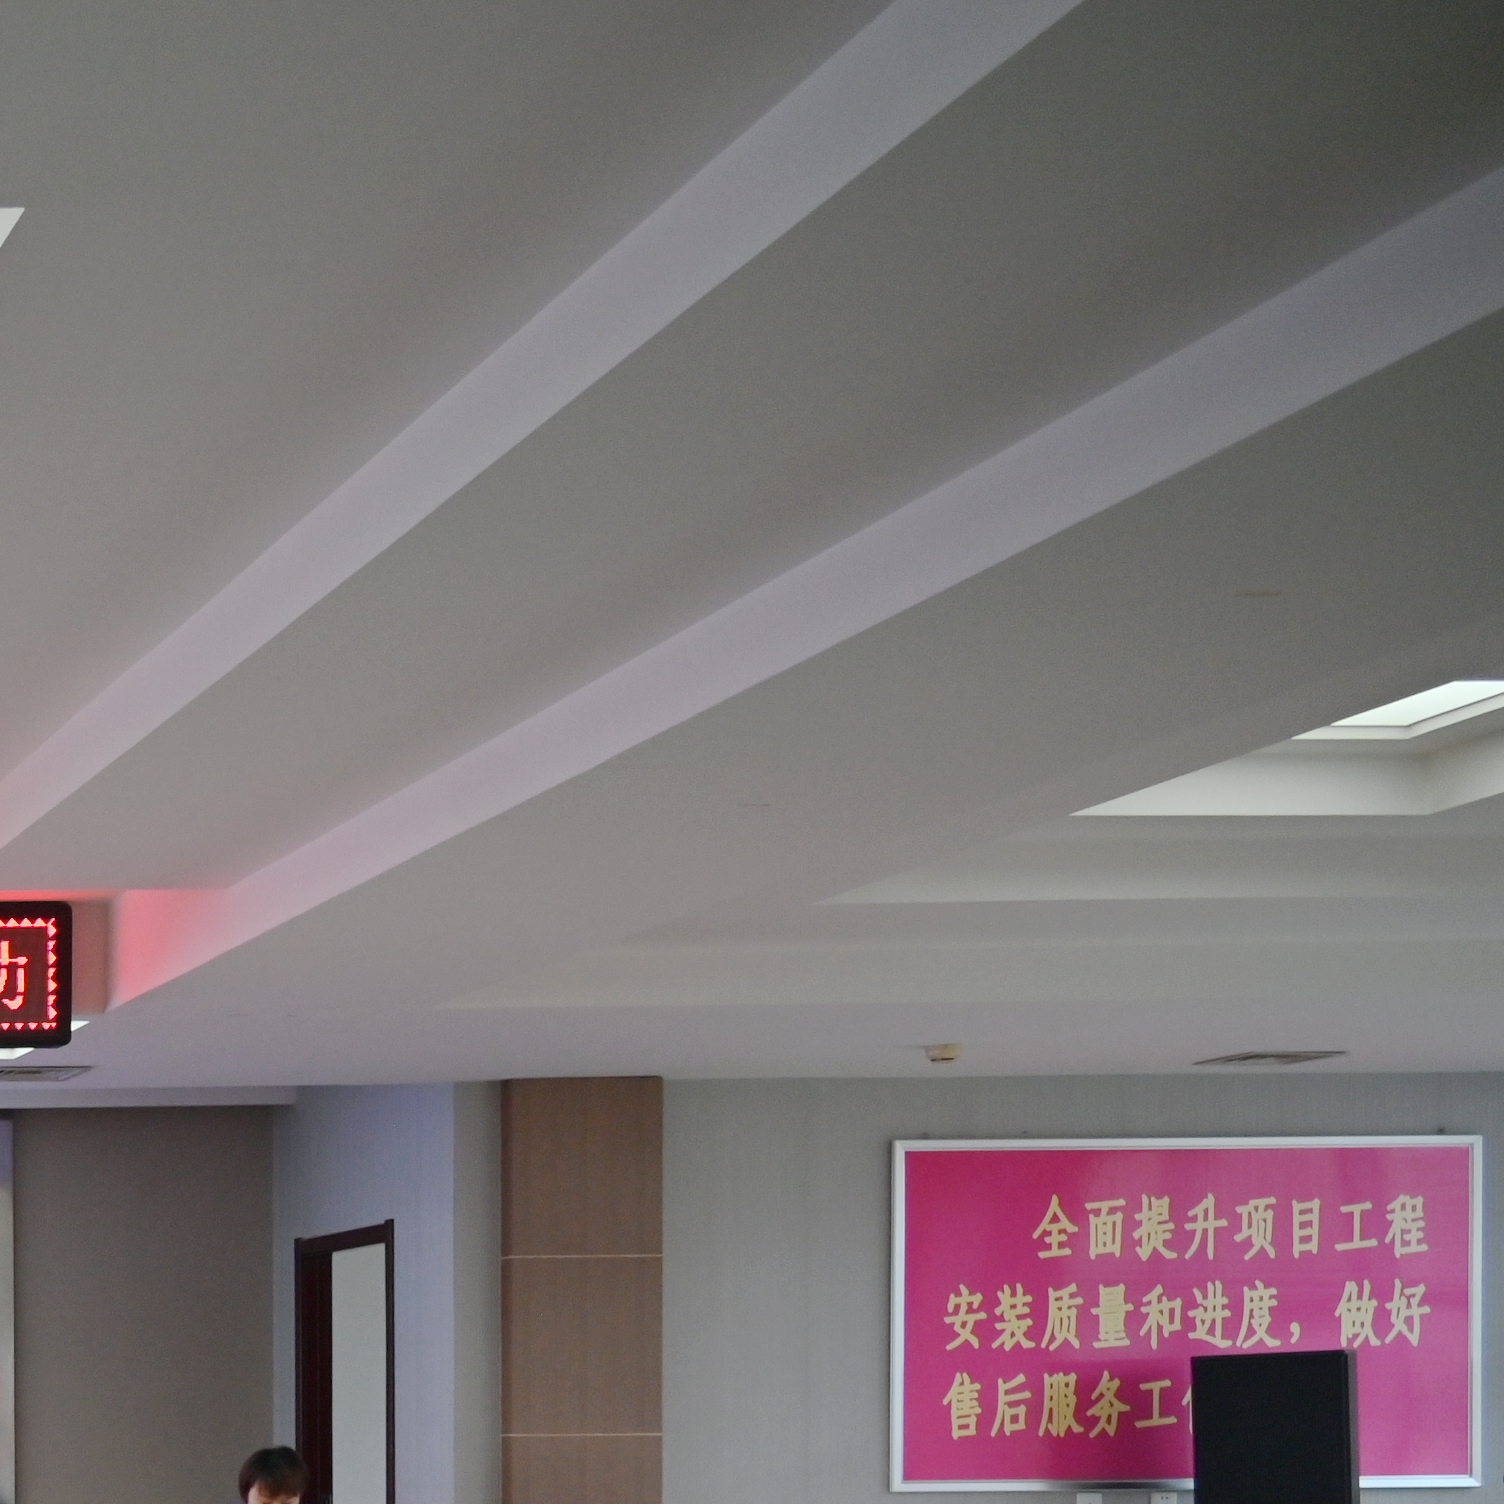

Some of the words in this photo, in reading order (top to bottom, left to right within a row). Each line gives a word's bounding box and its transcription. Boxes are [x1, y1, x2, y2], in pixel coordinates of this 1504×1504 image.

[1032, 1193, 1430, 1262] 全面提升项目工程
[943, 1277, 1431, 1351] 安装质量和进度，做好
[943, 1371, 1194, 1438] 售后服务工
